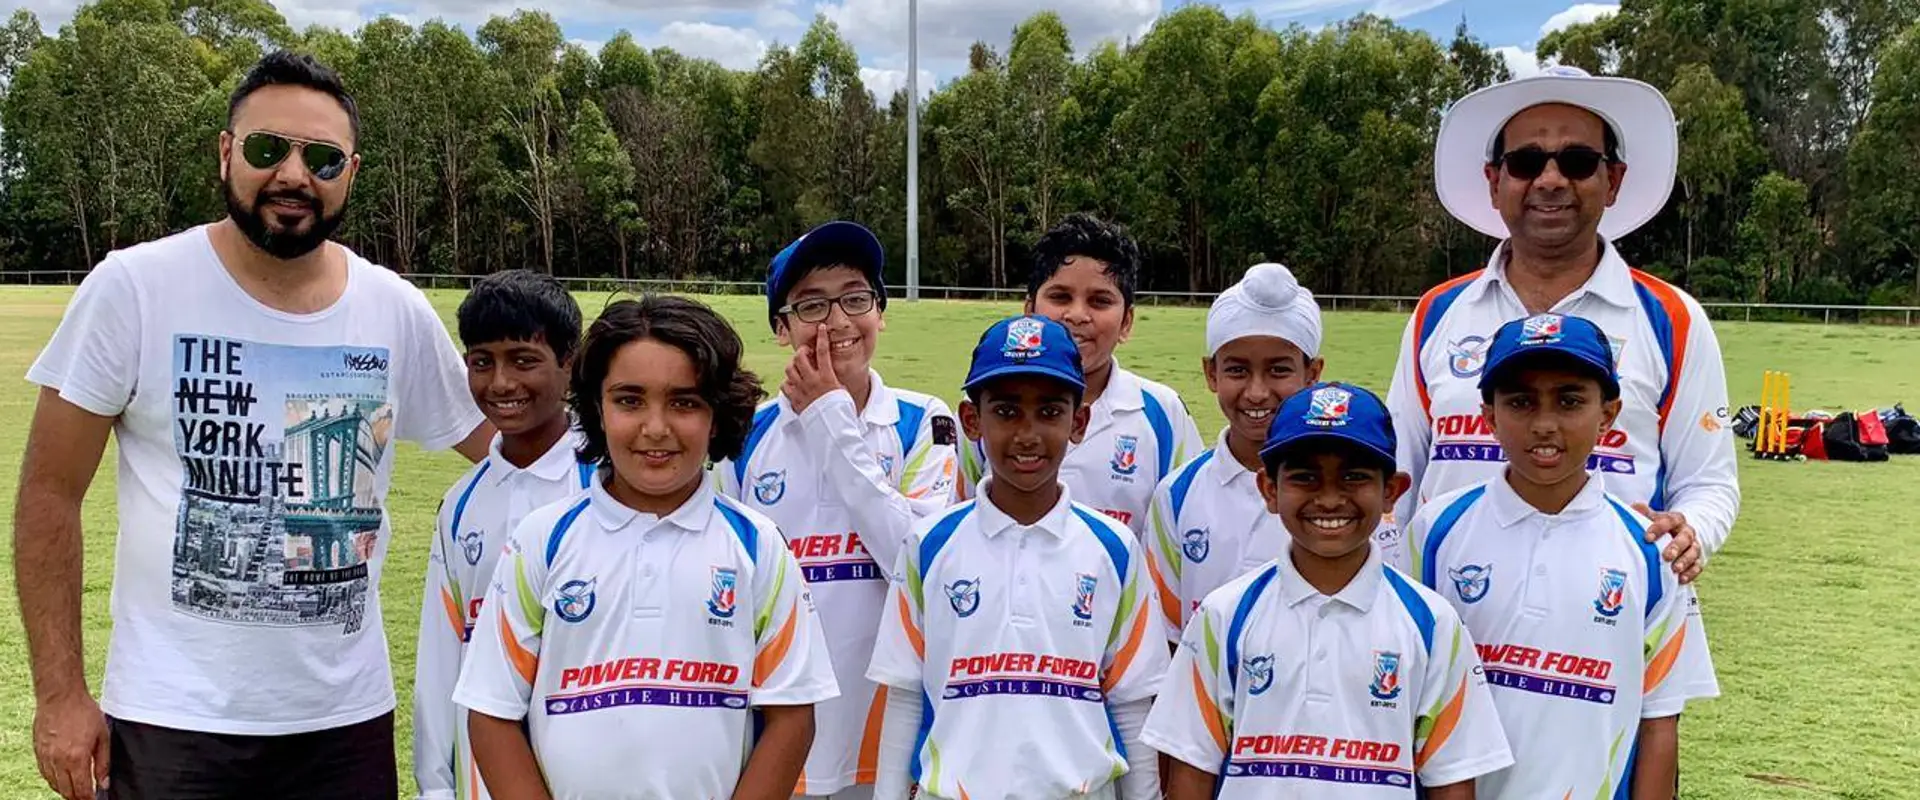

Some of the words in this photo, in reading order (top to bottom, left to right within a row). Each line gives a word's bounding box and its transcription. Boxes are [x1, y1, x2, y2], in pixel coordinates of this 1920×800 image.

[179, 337, 242, 376] THE
[176, 377, 256, 417] NEW
[1437, 414, 1494, 436] POW
[1441, 446, 1508, 460] CASTL
[181, 455, 304, 497] MINUTE
[559, 657, 663, 690] POWER
[662, 659, 740, 685] FORD
[949, 652, 1036, 678] POWER
[1037, 653, 1098, 680] FORD
[1474, 642, 1542, 669] WER
[1540, 651, 1613, 681] FORD
[569, 690, 653, 712] CASTLE
[669, 691, 718, 706] HILL
[1542, 680, 1594, 700] HILL
[1233, 734, 1330, 757] POWER
[1329, 737, 1402, 763] FORD
[1334, 768, 1382, 784] HILL
